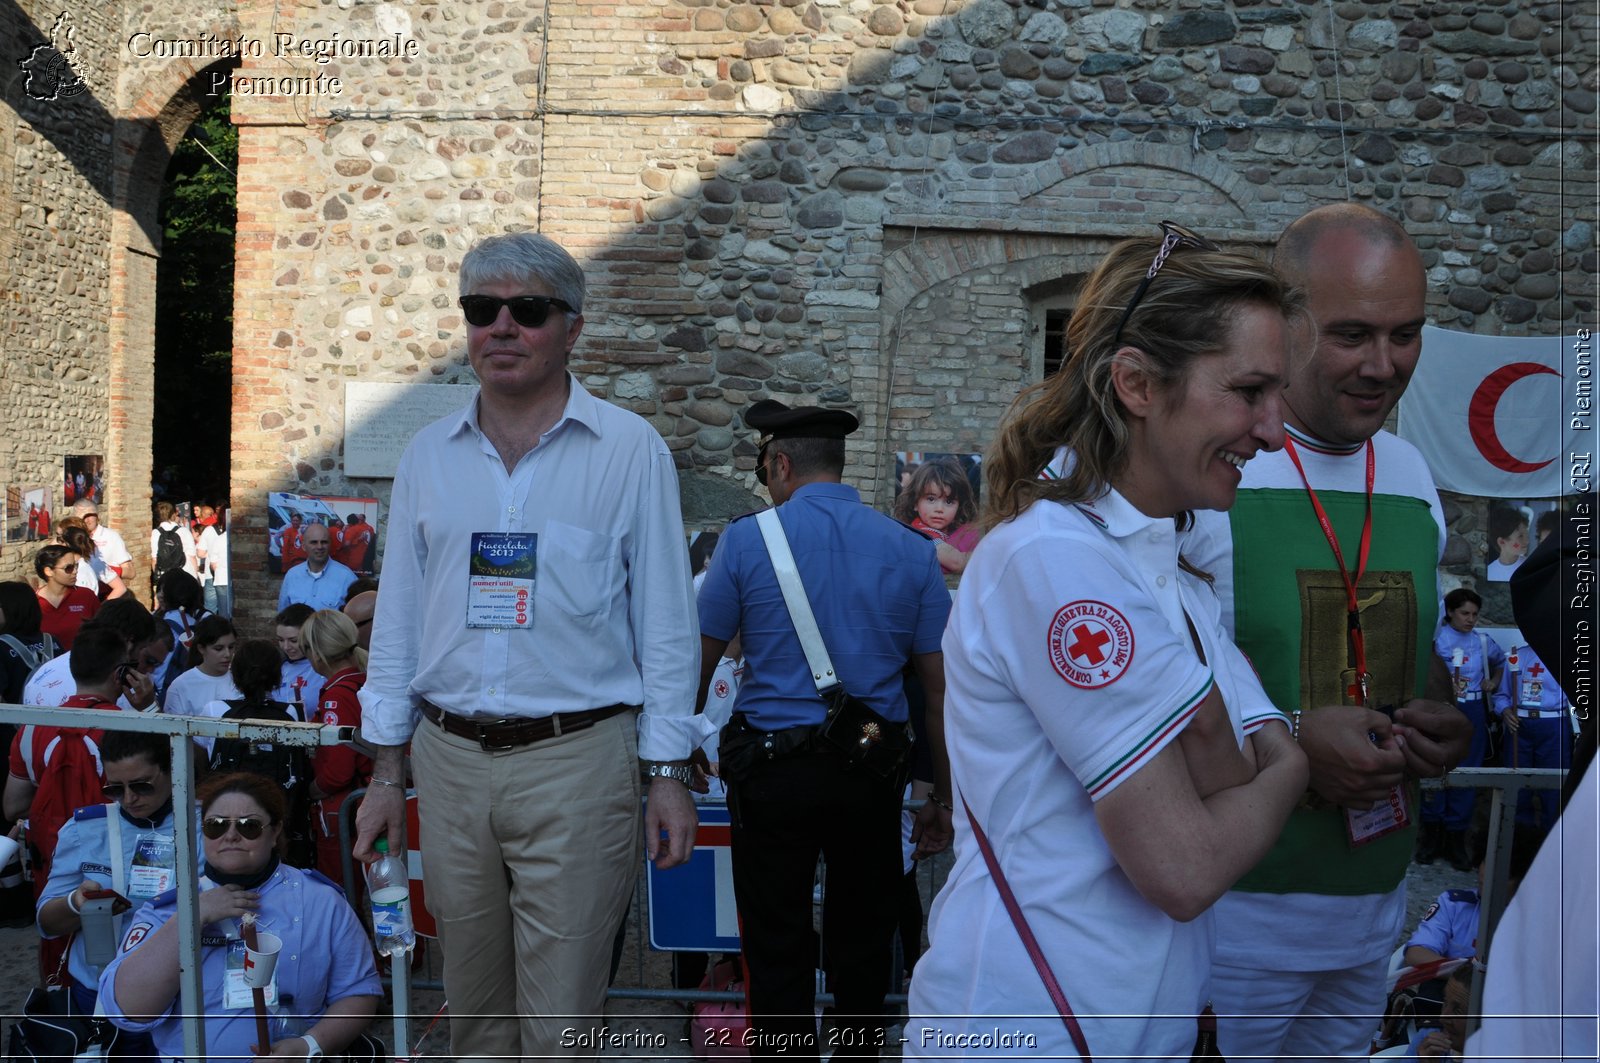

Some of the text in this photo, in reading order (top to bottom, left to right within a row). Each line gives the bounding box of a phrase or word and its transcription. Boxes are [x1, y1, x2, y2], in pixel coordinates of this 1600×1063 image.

[478, 541, 528, 552] fiaccolata
[1052, 605, 1129, 684] CONVENZIONE DI GINEVRA 22 AGOSTO 1864
